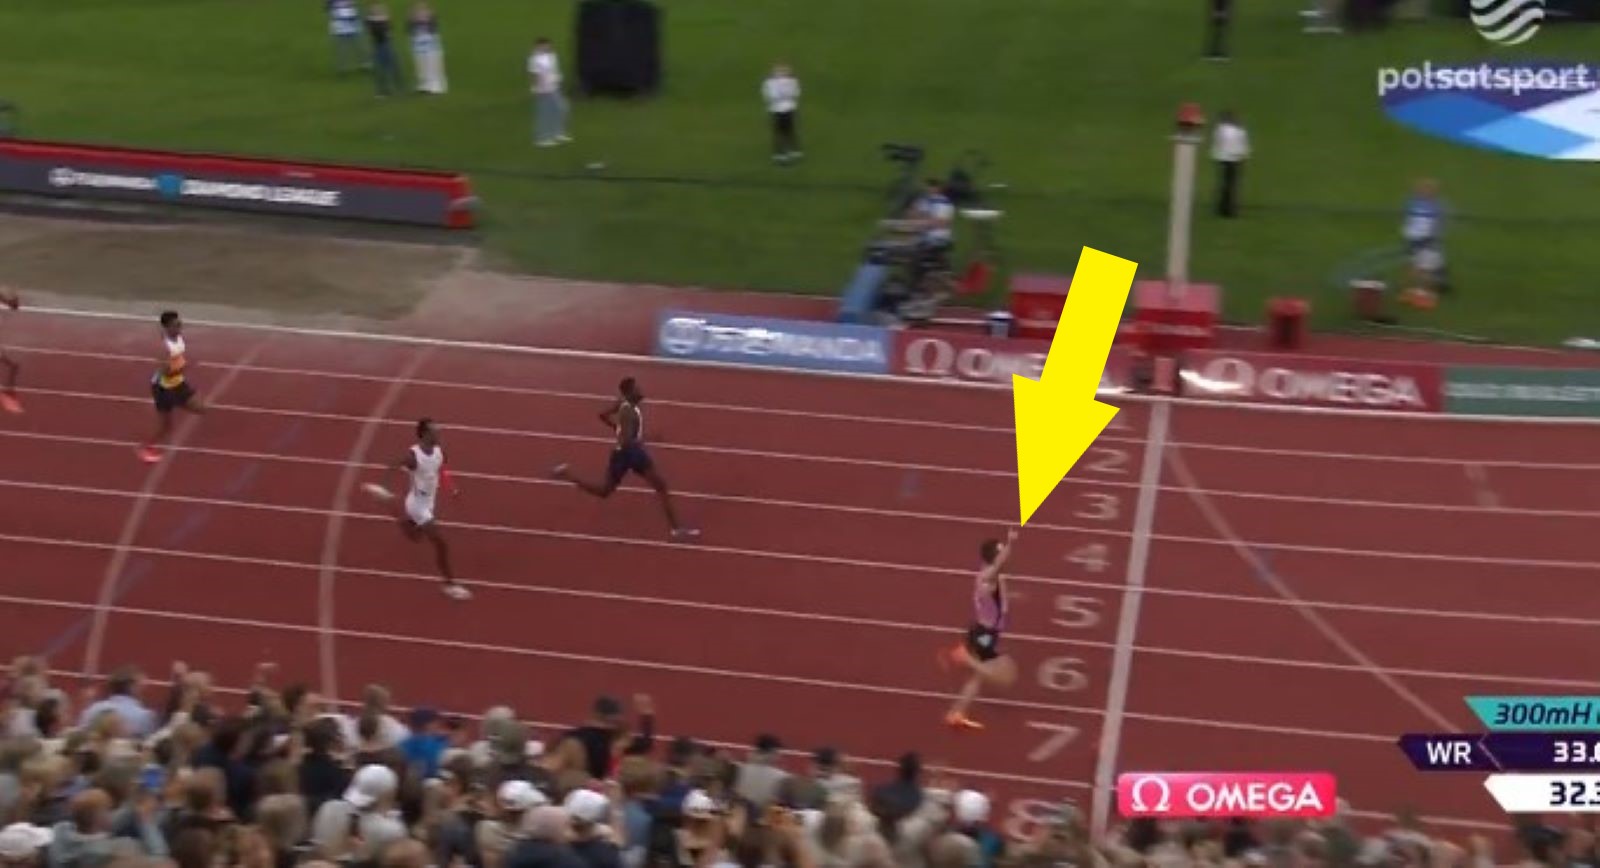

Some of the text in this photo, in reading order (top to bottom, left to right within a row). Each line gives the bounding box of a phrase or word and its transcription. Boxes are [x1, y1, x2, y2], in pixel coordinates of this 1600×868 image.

[1259, 367, 1426, 407] OMEGA
[1083, 447, 1129, 474] 2
[1073, 493, 1119, 521] 3
[1064, 544, 1112, 572] 4
[1051, 595, 1105, 628] 5
[1037, 657, 1089, 691] 6
[1025, 721, 1082, 762] 7
